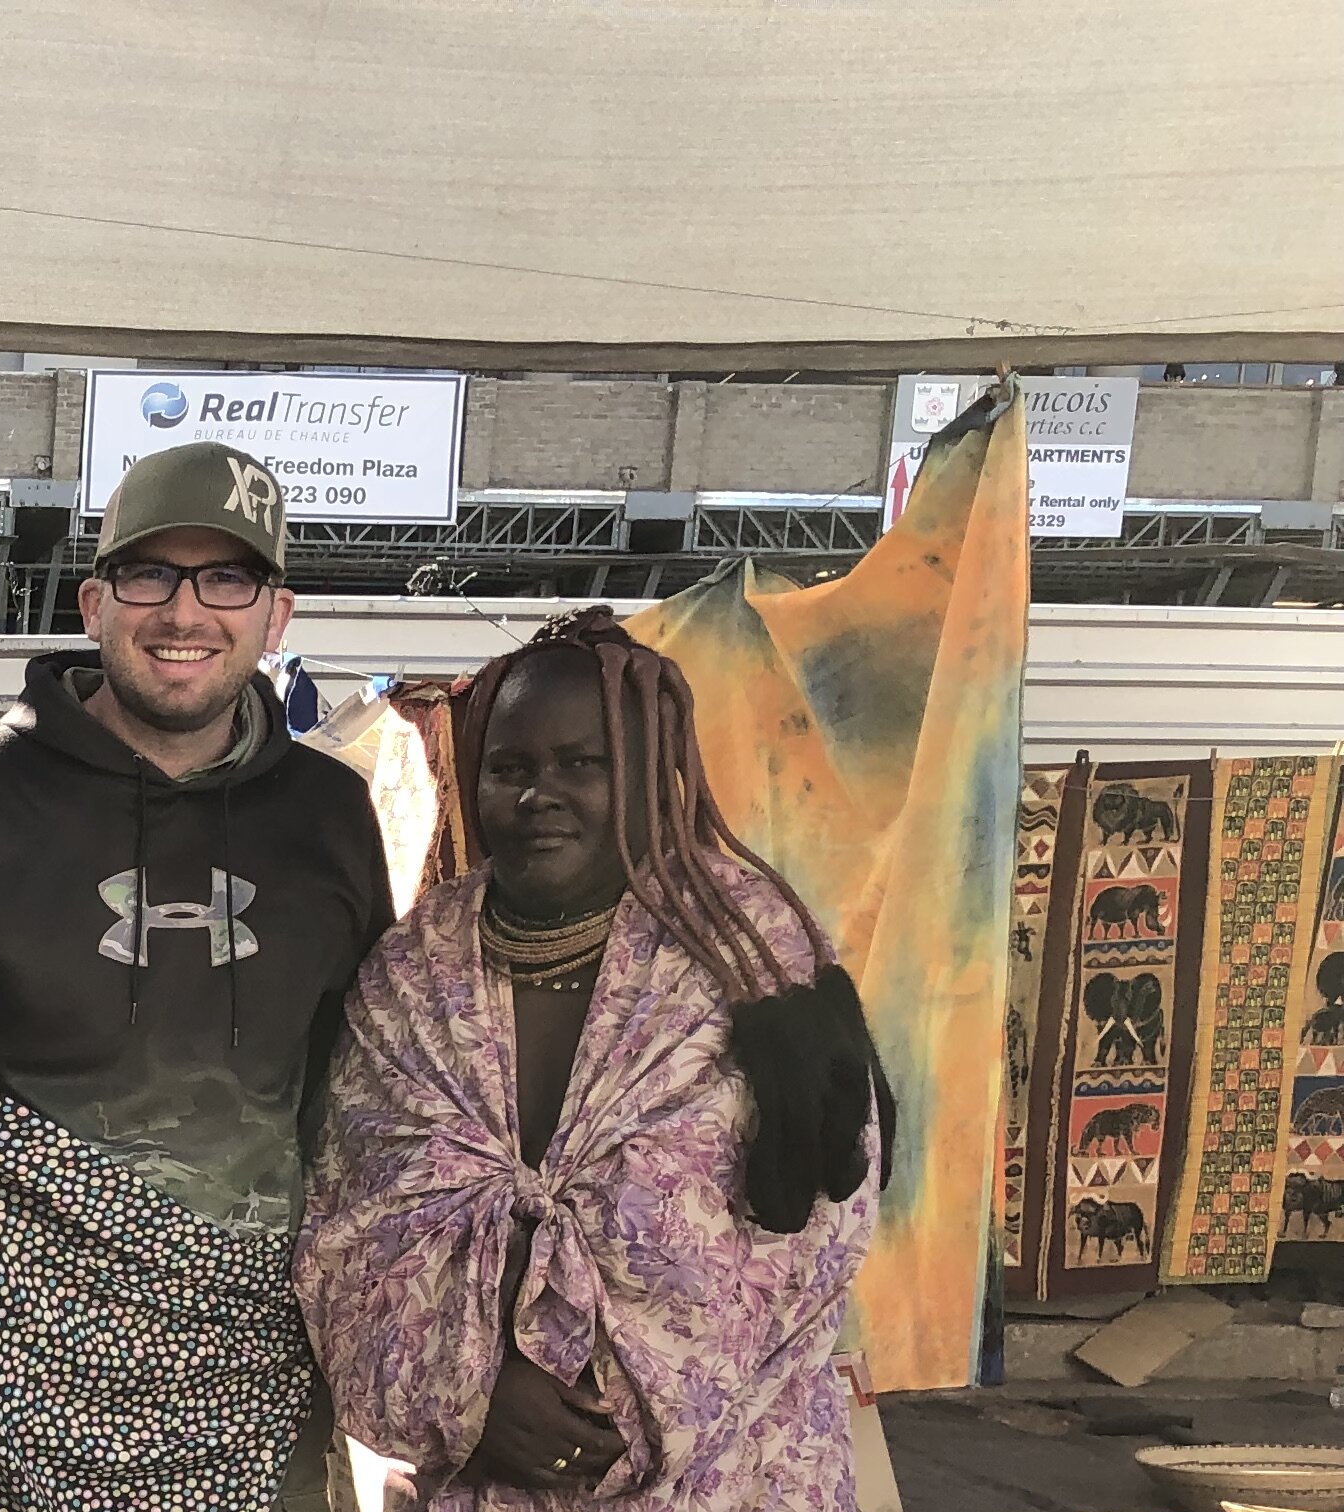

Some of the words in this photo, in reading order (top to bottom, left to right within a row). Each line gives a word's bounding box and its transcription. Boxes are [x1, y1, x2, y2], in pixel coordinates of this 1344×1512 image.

[1023, 383, 1112, 413] ncois
[199, 390, 411, 434] RealTransfer
[1026, 415, 1073, 435] rties
[194, 429, 257, 441] BUREAU
[264, 429, 283, 442] DE
[289, 430, 351, 444] CHANGE
[263, 456, 354, 477] Freedom
[362, 458, 418, 479] Plaza
[325, 485, 367, 505] 090
[1039, 495, 1086, 508] Rental
[1089, 497, 1121, 512] only
